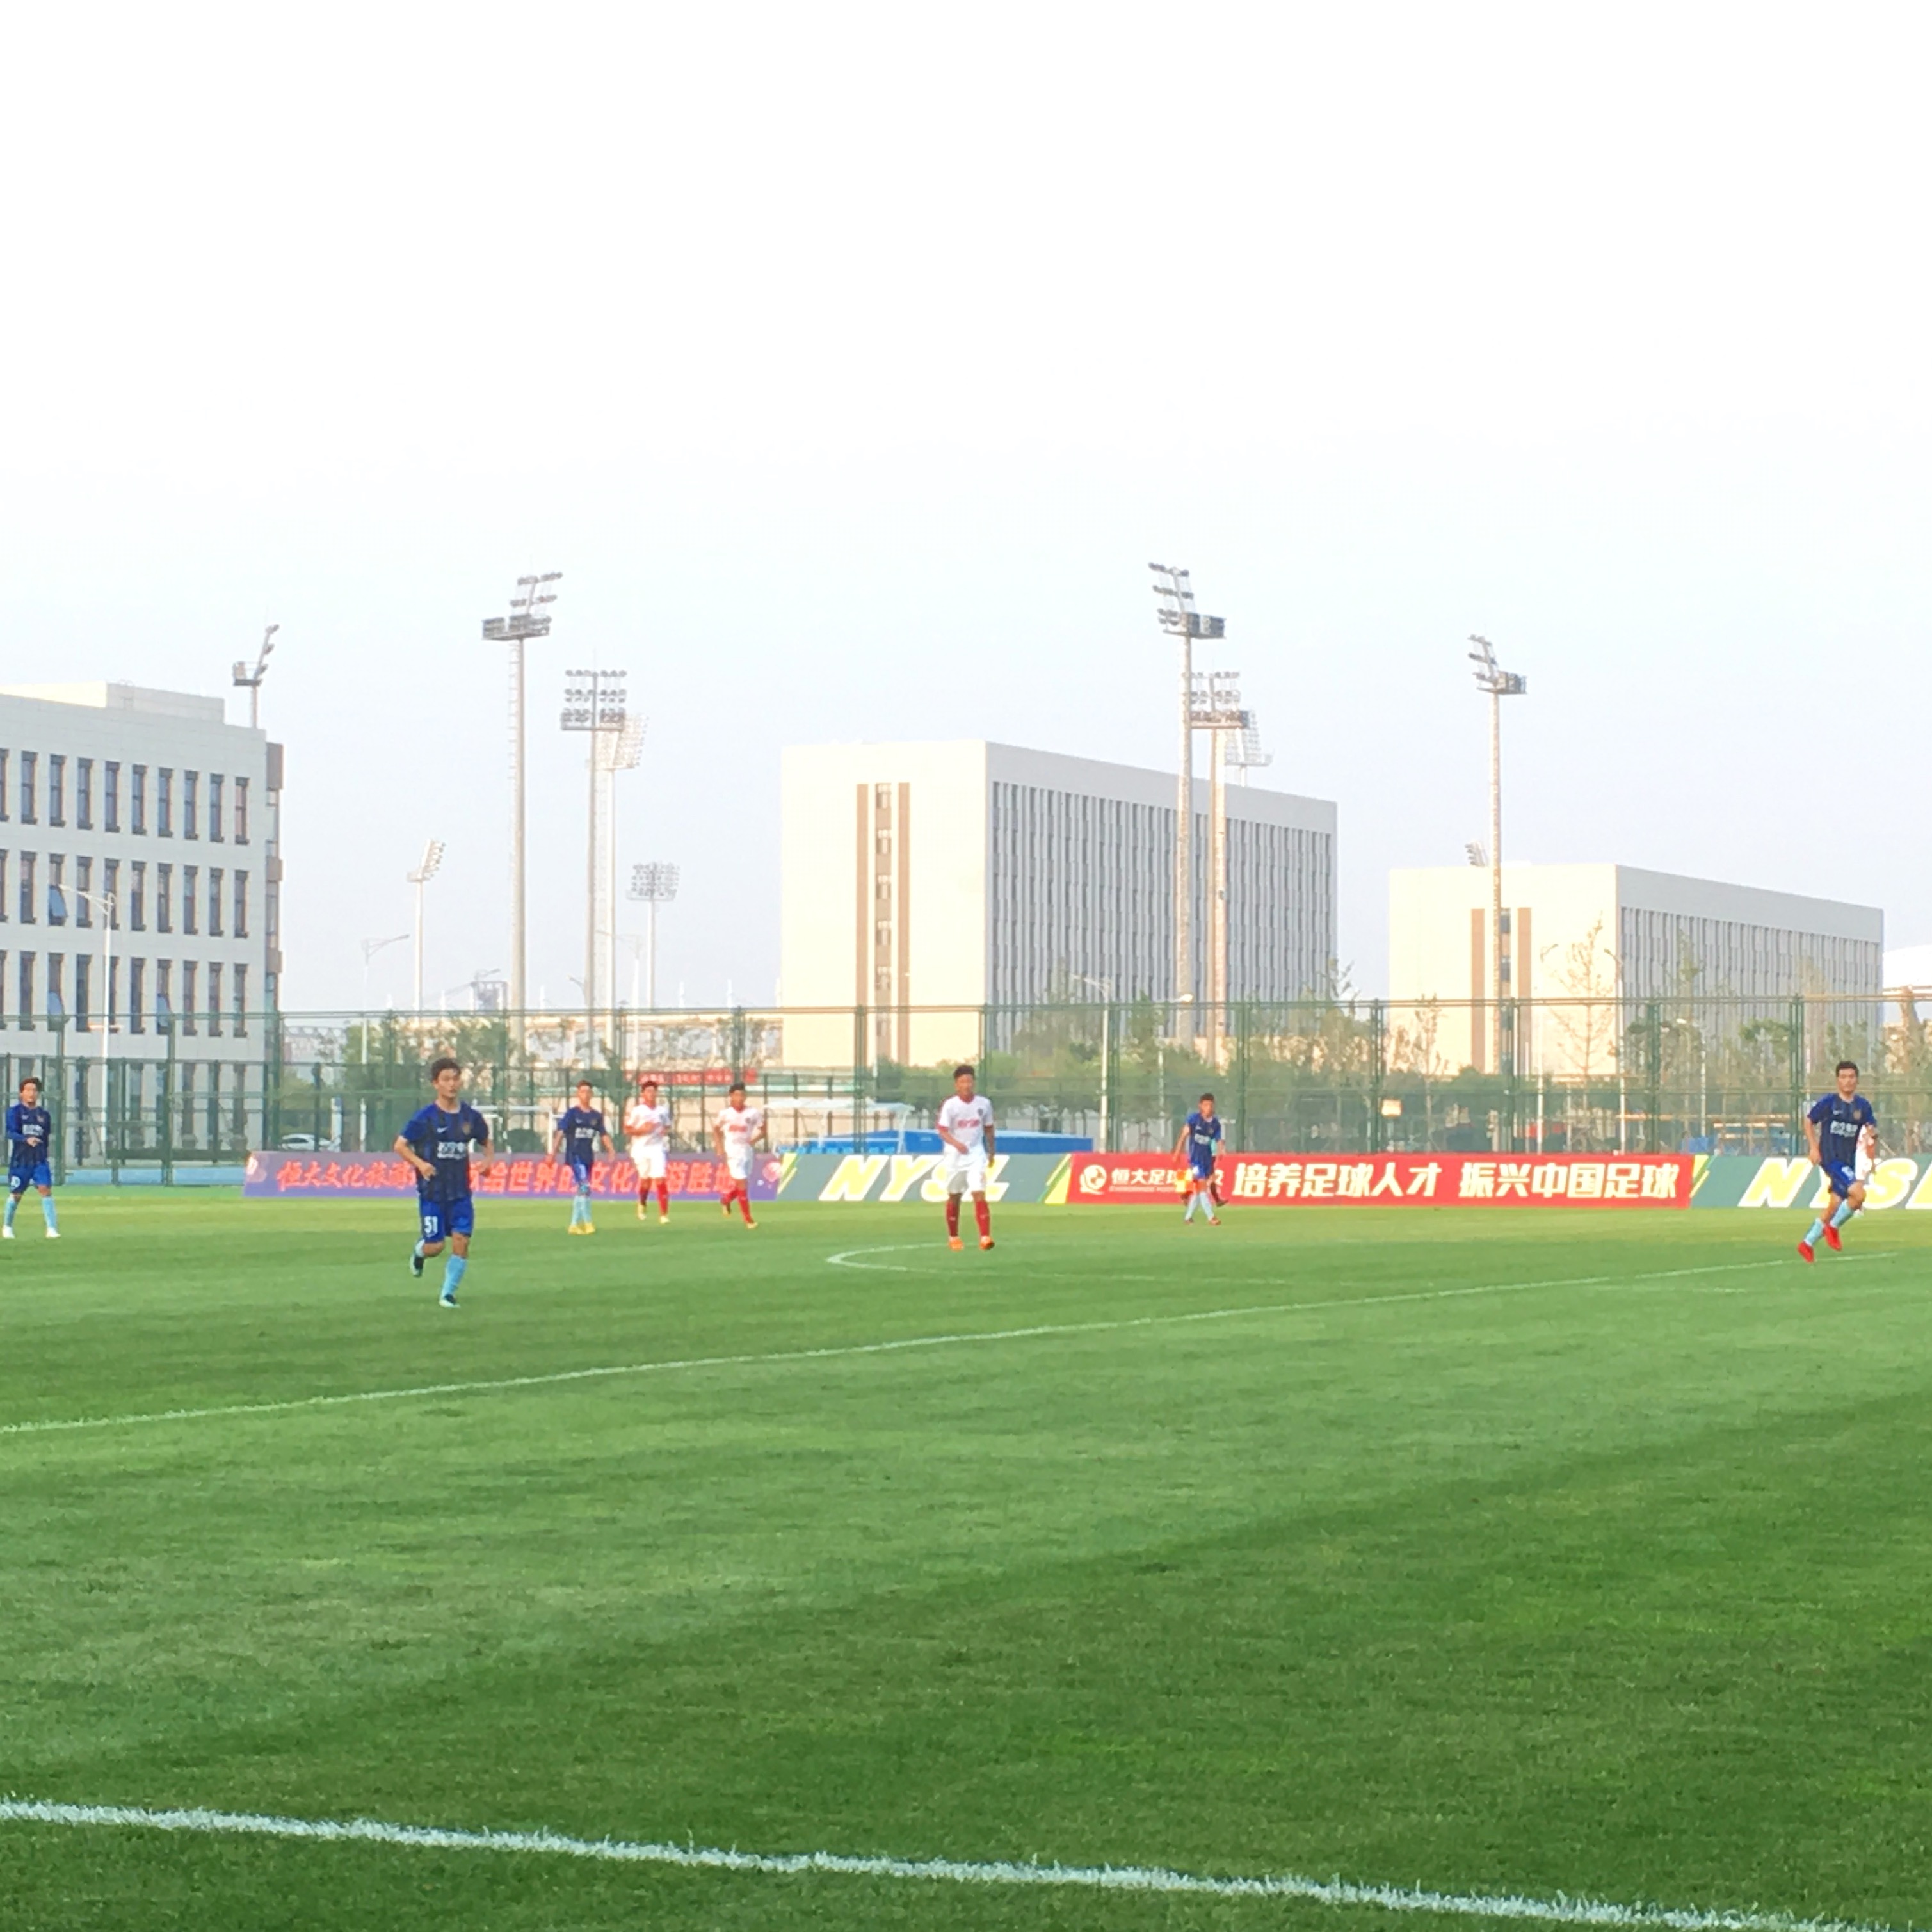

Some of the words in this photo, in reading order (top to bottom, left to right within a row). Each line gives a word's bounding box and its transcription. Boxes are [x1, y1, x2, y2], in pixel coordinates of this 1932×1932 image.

[1232, 1161, 1442, 1198] 培养足球人才
[1459, 1161, 1679, 1198] 振兴中国足球
